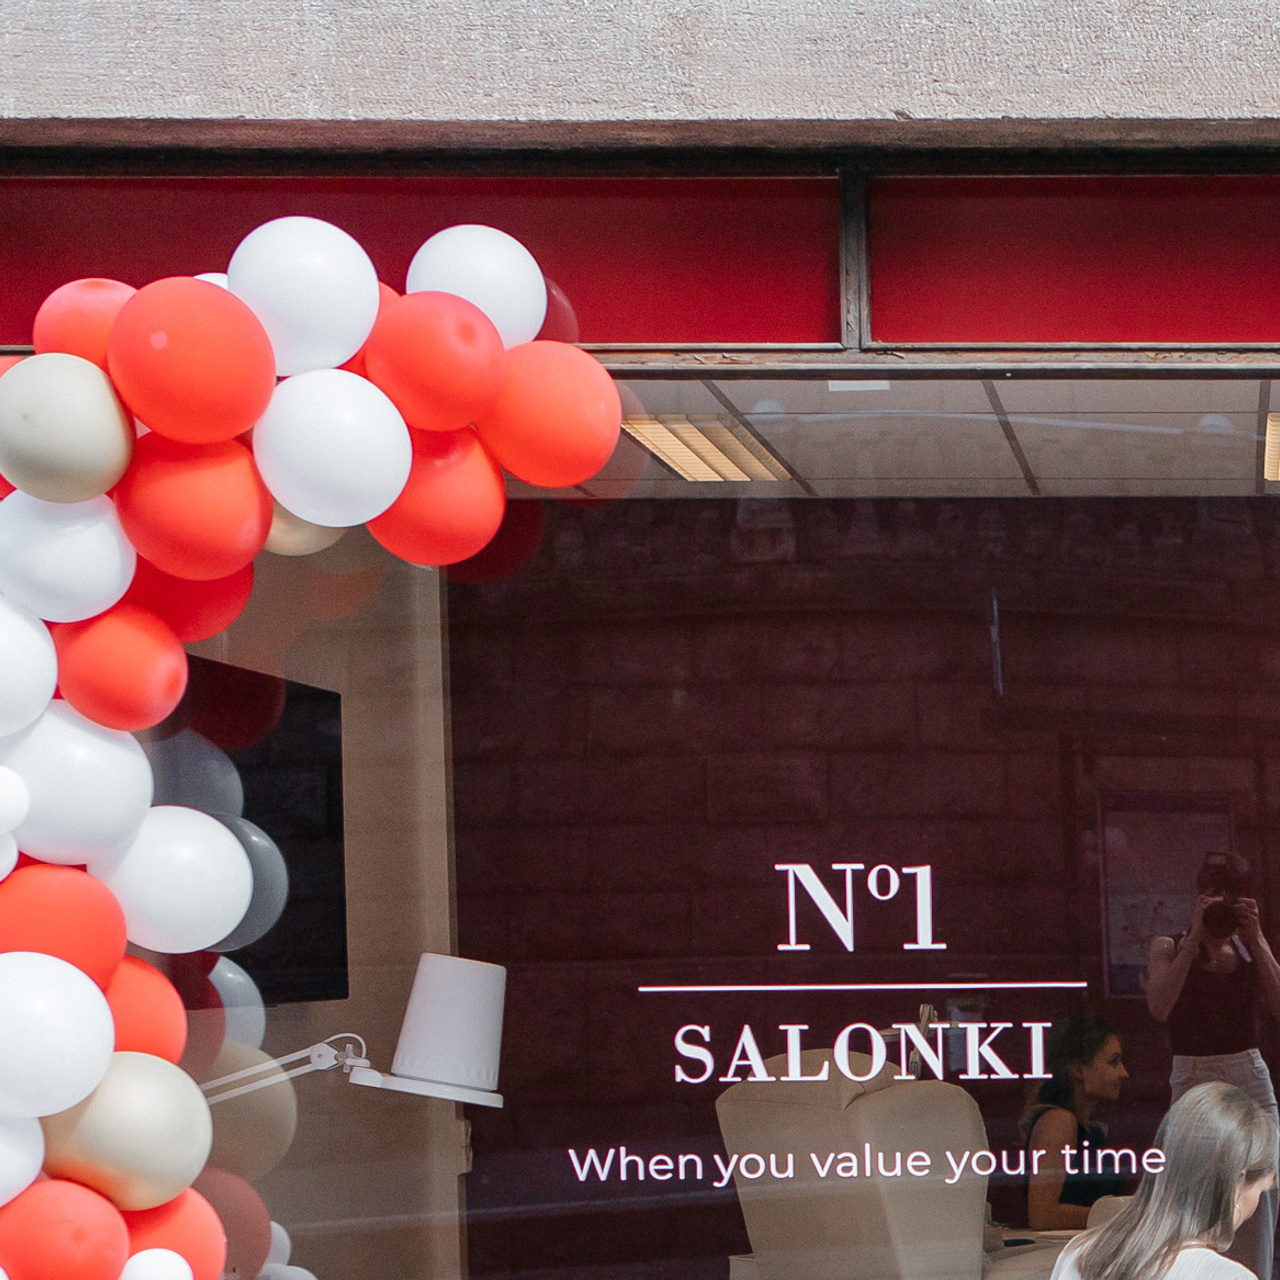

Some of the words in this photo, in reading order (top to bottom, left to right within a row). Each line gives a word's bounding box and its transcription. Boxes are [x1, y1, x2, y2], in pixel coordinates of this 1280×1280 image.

[674, 1022, 1053, 1084] SALONKI
[568, 1146, 703, 1182] When
[712, 1152, 795, 1188] you
[809, 1142, 932, 1178] value
[944, 1149, 1047, 1185] your
[1060, 1140, 1167, 1176] time
